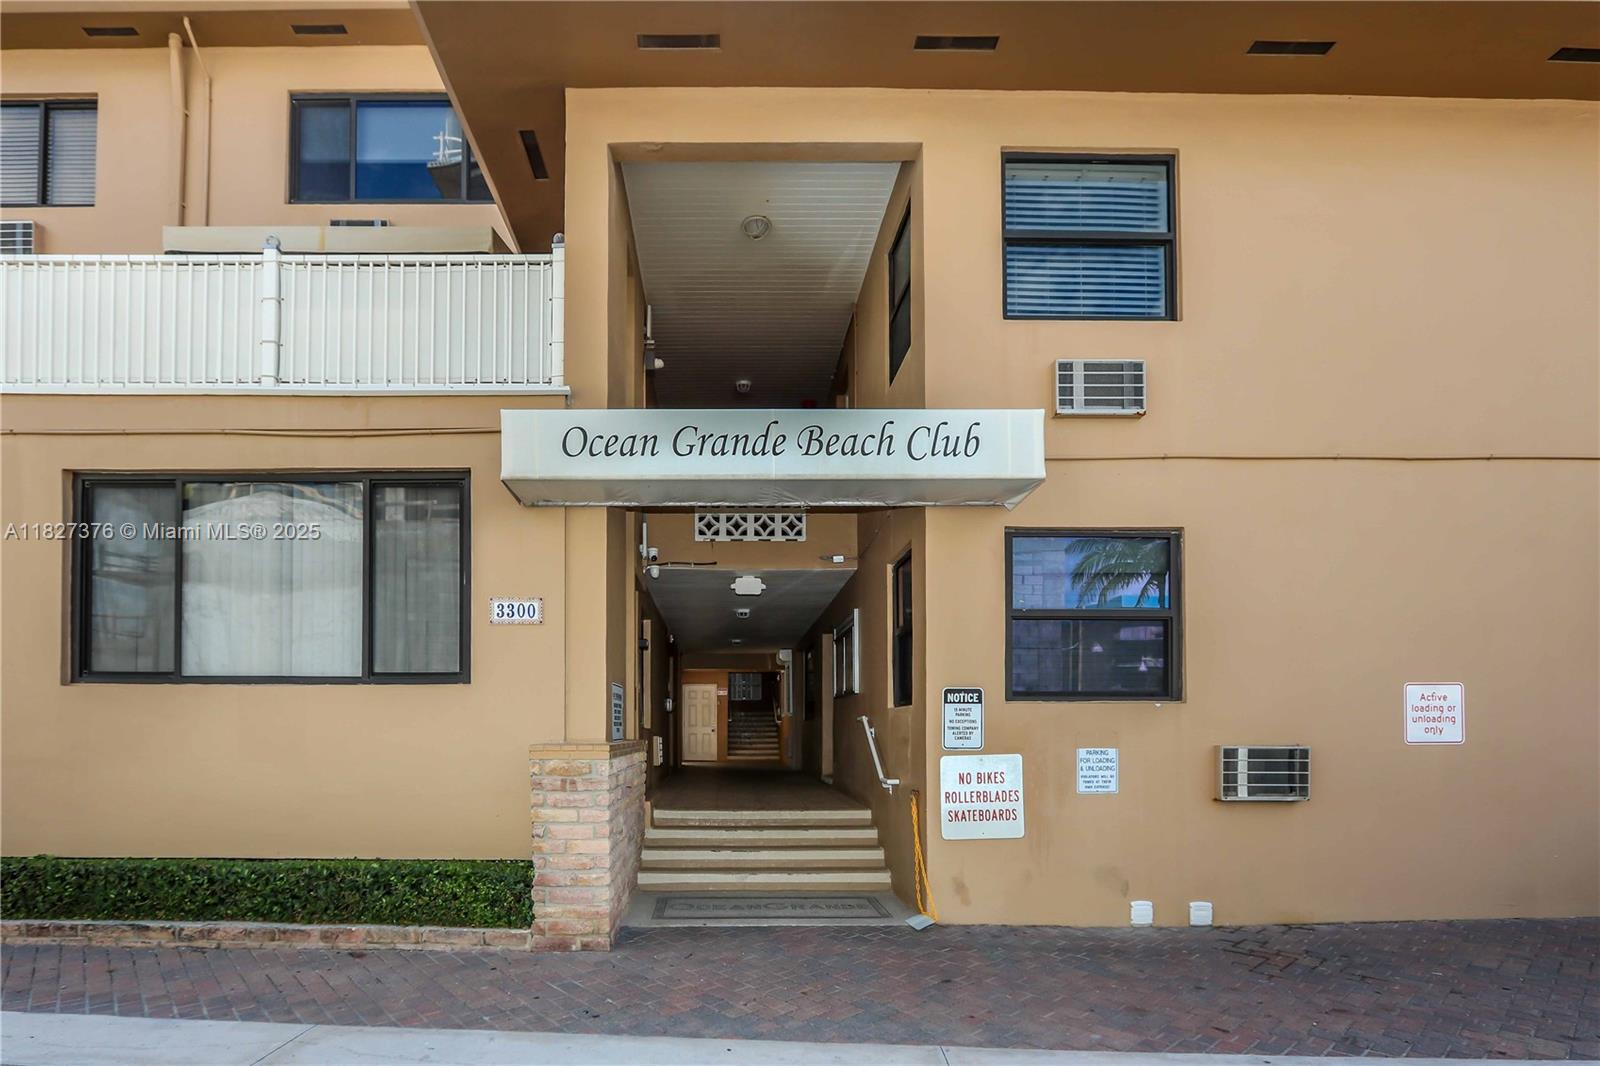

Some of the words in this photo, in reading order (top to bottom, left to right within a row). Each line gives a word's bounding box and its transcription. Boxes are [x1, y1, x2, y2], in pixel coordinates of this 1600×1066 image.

[562, 426, 659, 457] Ocean
[672, 420, 787, 457] Grande
[797, 420, 896, 457] Beach
[907, 421, 981, 461] Club
[496, 603, 536, 618] 3300
[947, 693, 979, 703] NOTICE
[1420, 692, 1447, 701] Active
[1411, 704, 1444, 714] loading
[1412, 716, 1456, 725] unloading
[1424, 726, 1444, 736] only
[959, 772, 972, 785] NO
[976, 771, 1006, 785] BIKES
[944, 790, 1020, 804] ROLLERBLADES
[947, 808, 1018, 822] SKATEBOARDS
